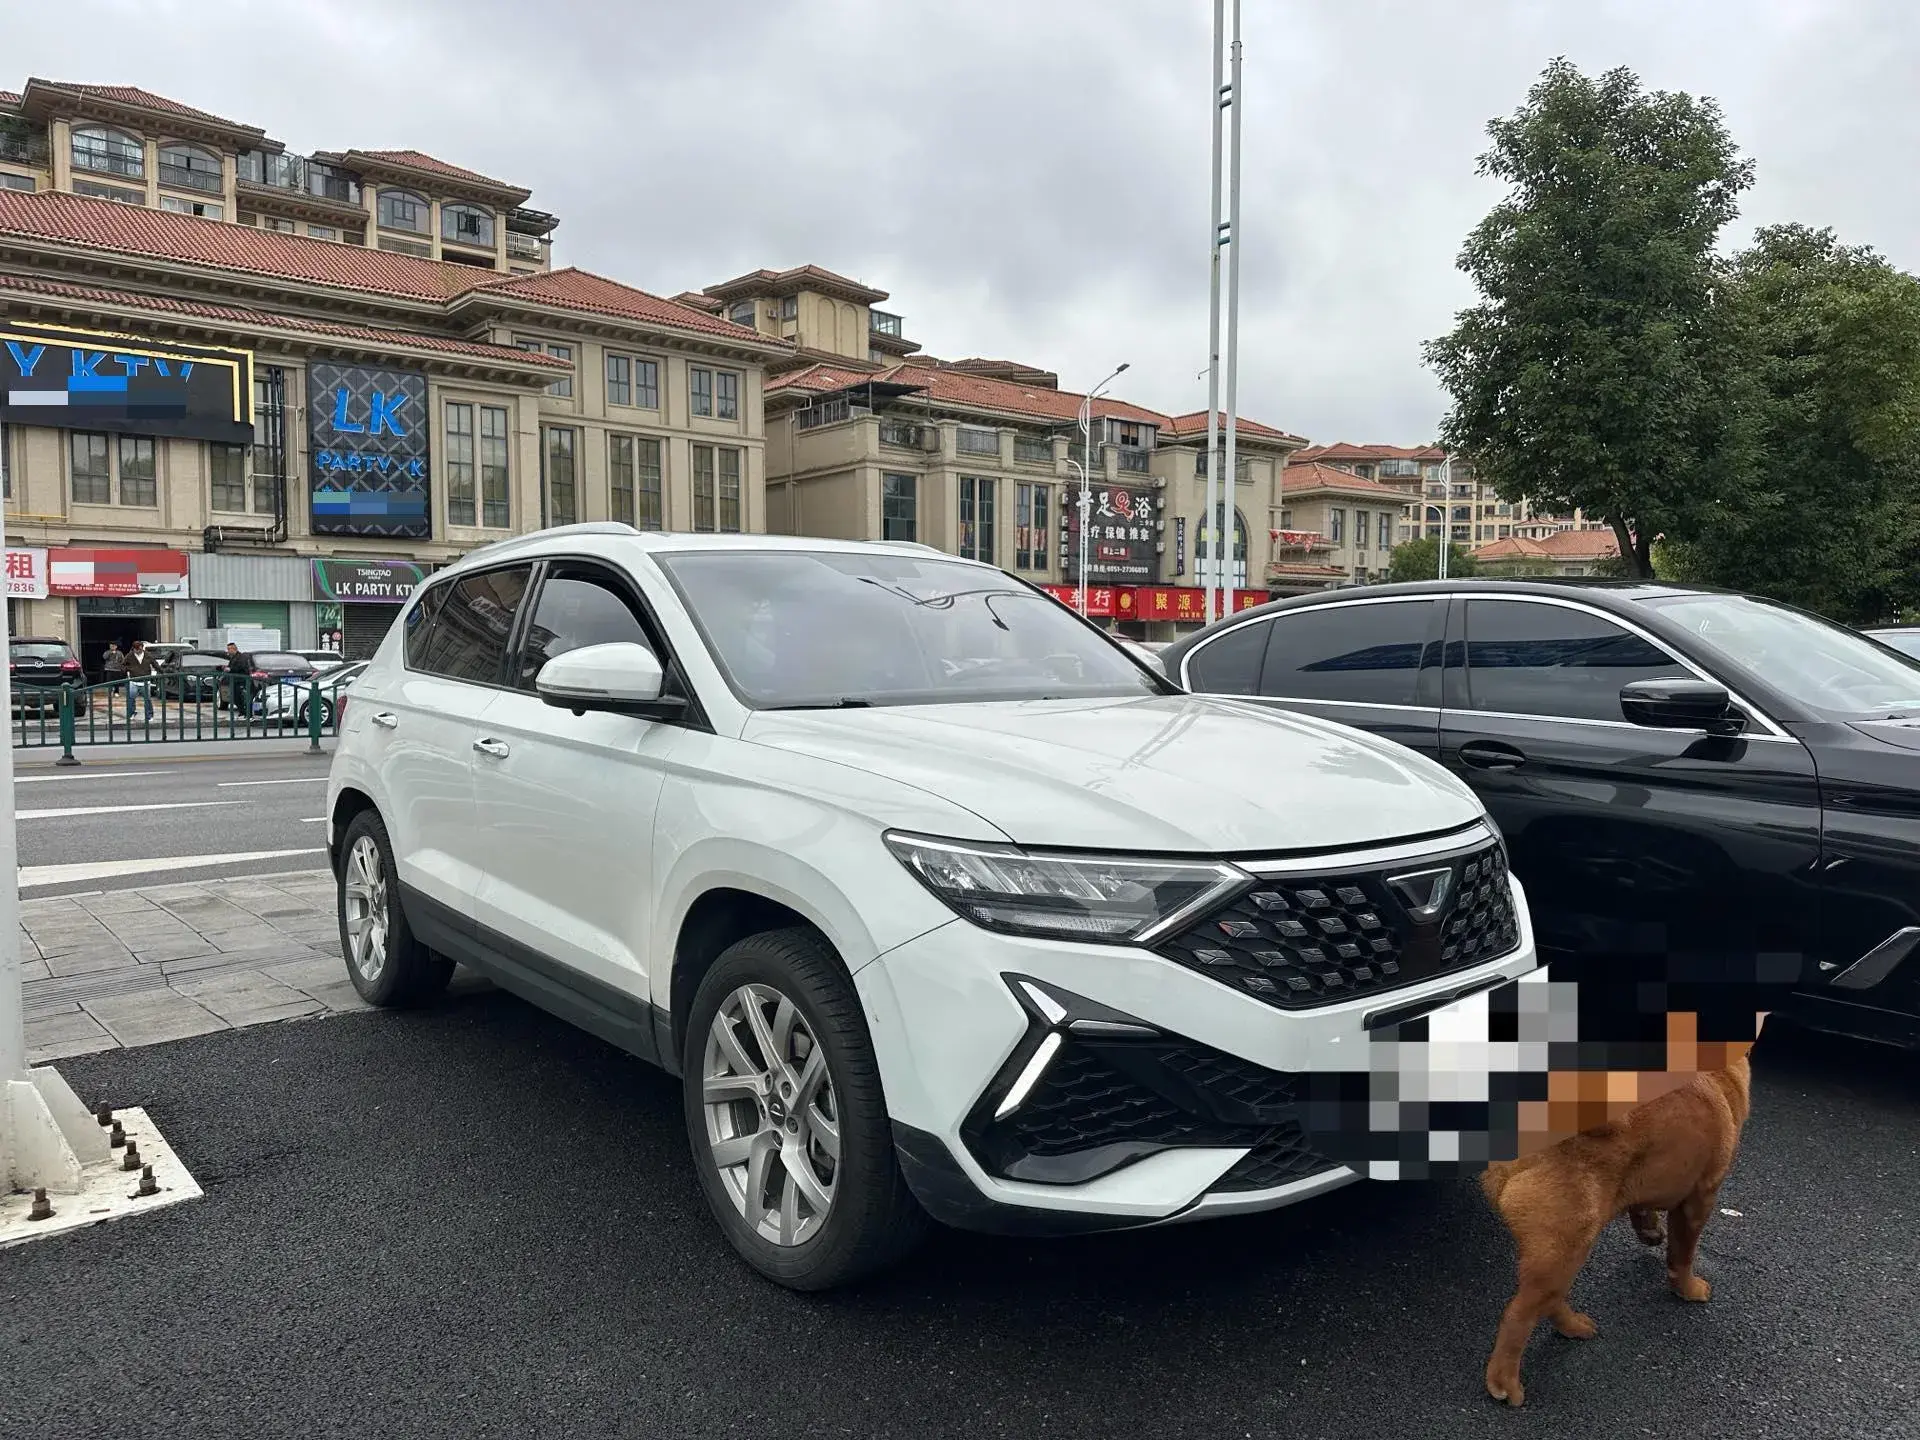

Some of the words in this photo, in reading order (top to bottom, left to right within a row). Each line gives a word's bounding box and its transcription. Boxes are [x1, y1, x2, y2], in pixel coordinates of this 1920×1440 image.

[333, 387, 410, 437] LK
[316, 450, 392, 473] PARTY
[1105, 526, 1126, 540] 保健
[1129, 527, 1149, 541] 推拿
[6, 553, 35, 578] 租
[357, 569, 391, 577] TSINGTAO
[7, 583, 35, 592] 7836
[336, 583, 351, 594] LK
[356, 584, 391, 595] PARTY
